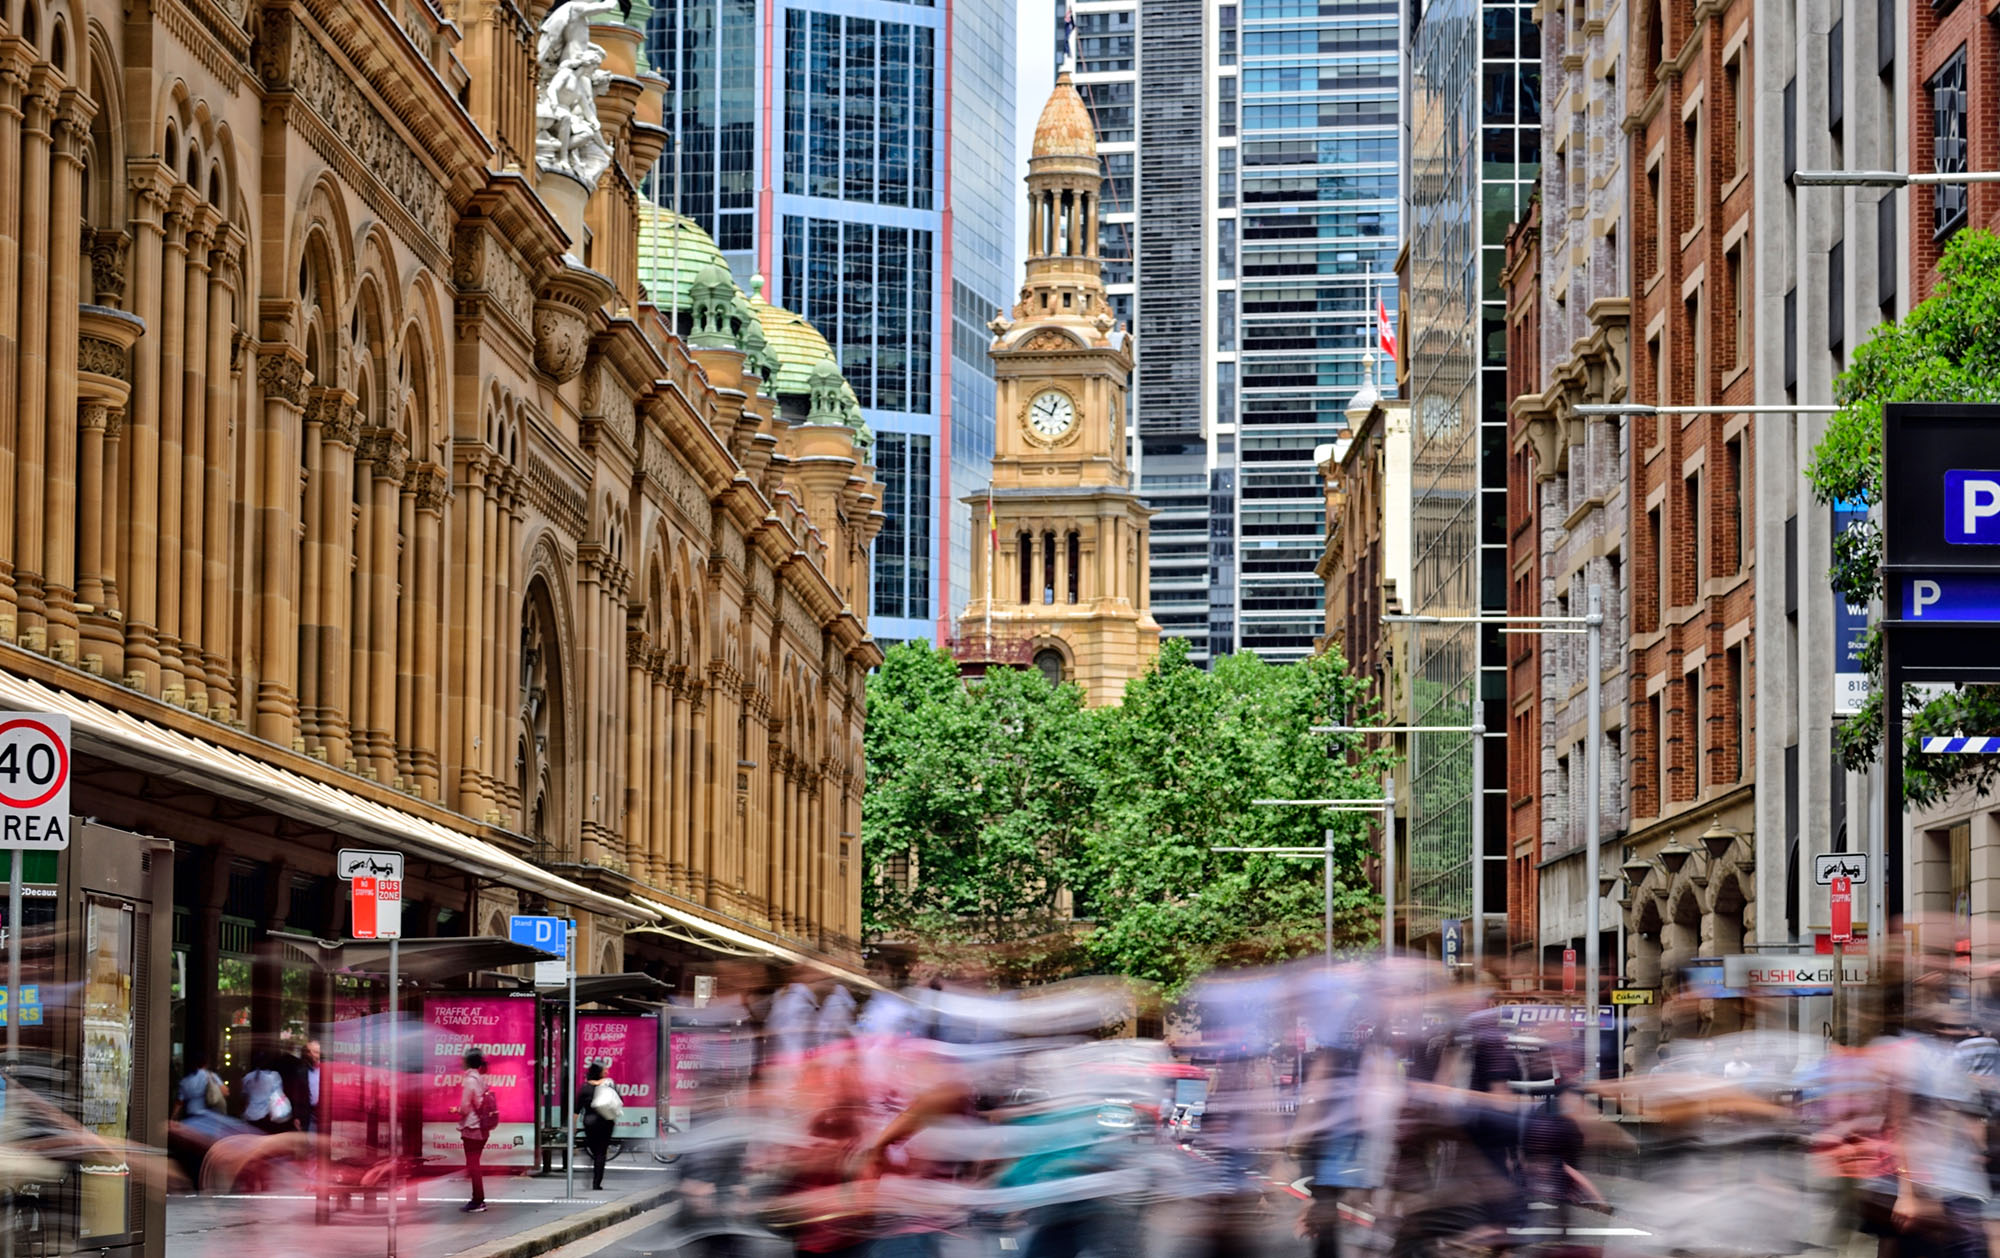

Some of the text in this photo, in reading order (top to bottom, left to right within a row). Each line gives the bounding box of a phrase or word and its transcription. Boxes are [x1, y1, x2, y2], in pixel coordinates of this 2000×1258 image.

[1963, 479, 2000, 534] P
[1913, 580, 1941, 616] P
[0, 743, 55, 785] 40
[0, 815, 64, 841] REA
[380, 881, 399, 890] BUS
[1836, 881, 1846, 892] NO
[379, 891, 400, 900] ZONE
[536, 920, 551, 942] D
[1748, 969, 1795, 983] SUSHI
[1818, 969, 1864, 982] GILL
[435, 1007, 482, 1016] TRAFFIC AT
[434, 1016, 500, 1025] A STAND STILL?
[584, 1024, 628, 1033] JUST BEEN
[434, 1034, 474, 1043] GO FROM
[584, 1047, 625, 1056] GO FROM
[435, 1065, 446, 1074] TO
